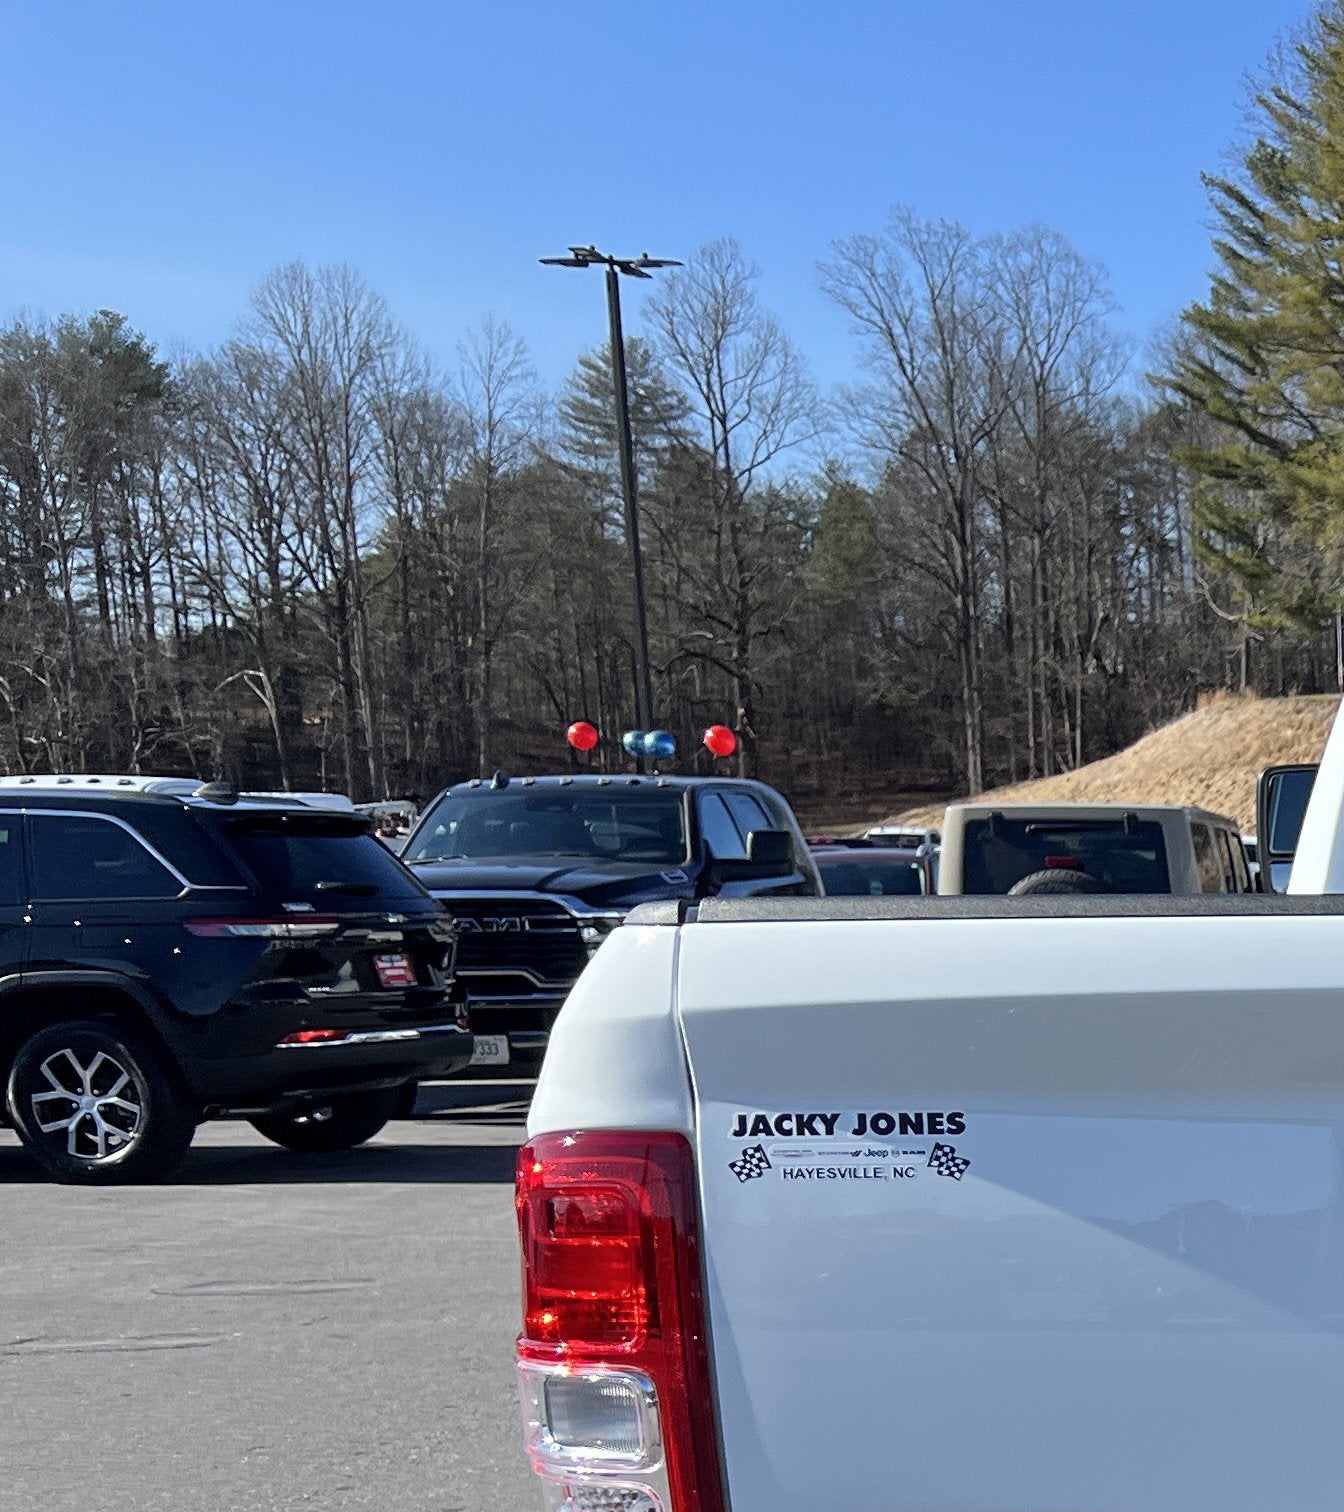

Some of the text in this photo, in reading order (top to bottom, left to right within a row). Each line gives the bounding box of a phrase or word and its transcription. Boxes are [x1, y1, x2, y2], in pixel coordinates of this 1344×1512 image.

[452, 917, 521, 933] AM
[732, 1111, 967, 1137] JACKY JONES
[863, 1147, 889, 1159] Jeep
[783, 1166, 916, 1180] HAYESVILLE, NC
